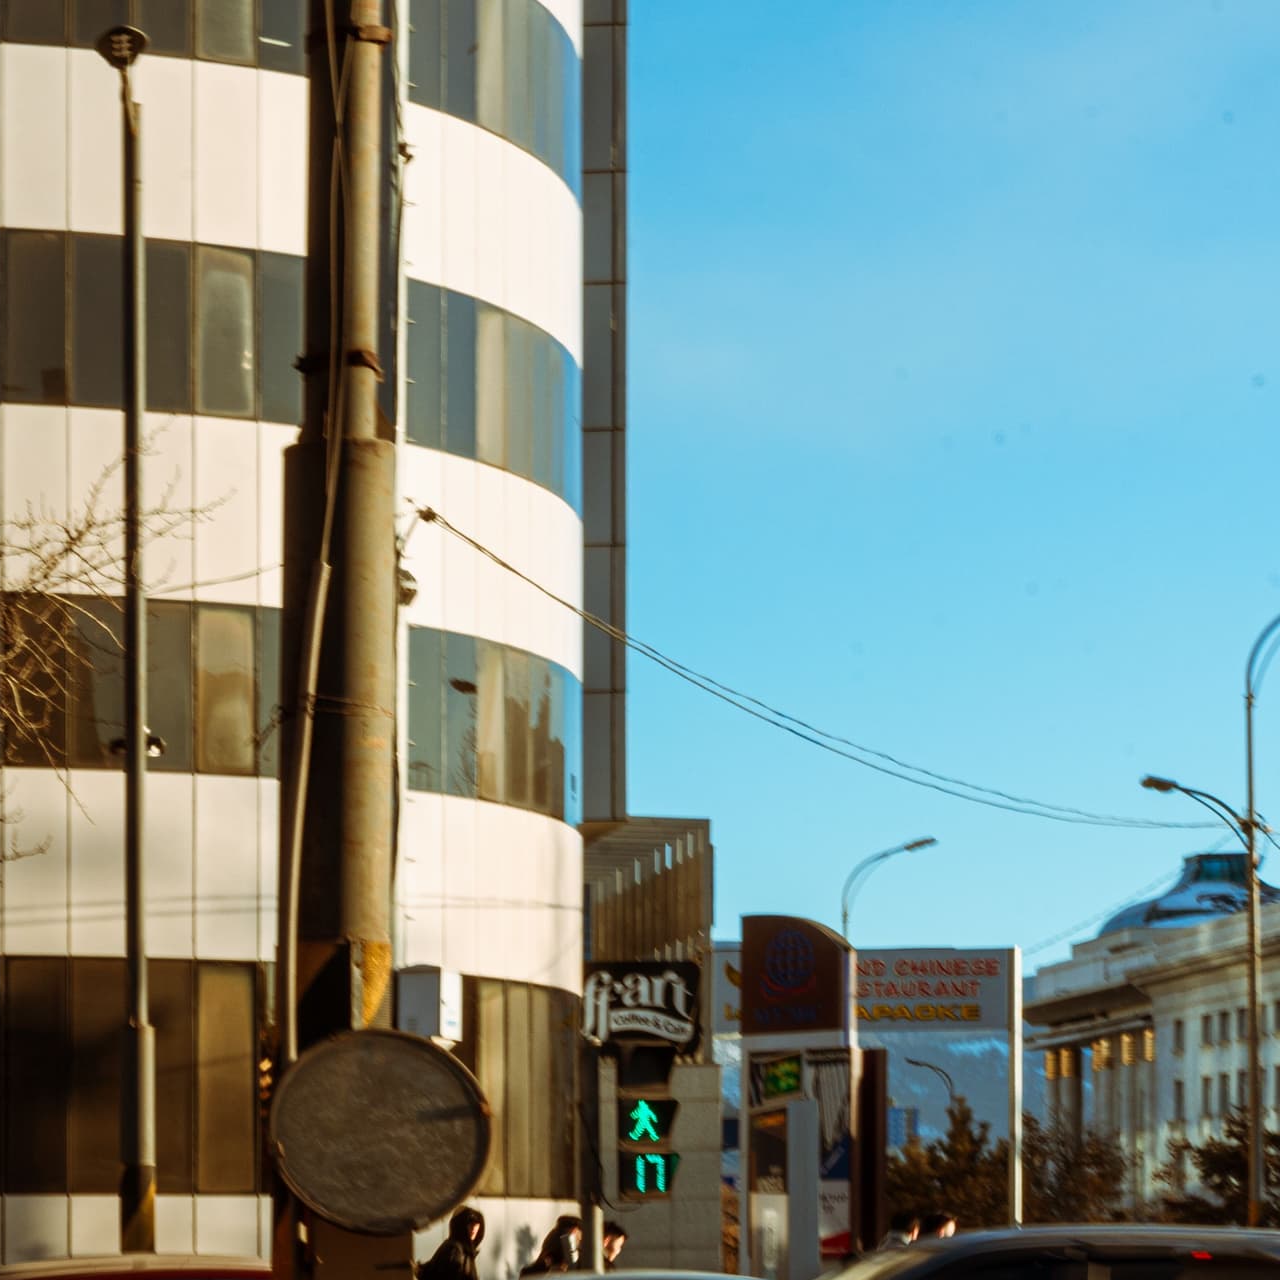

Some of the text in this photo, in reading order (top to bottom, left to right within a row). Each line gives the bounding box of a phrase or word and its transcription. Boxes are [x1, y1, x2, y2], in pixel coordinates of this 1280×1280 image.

[856, 958, 1000, 977] ND CHINESE
[856, 980, 981, 998] STAURANT
[854, 1003, 981, 1022] ARAOKE
